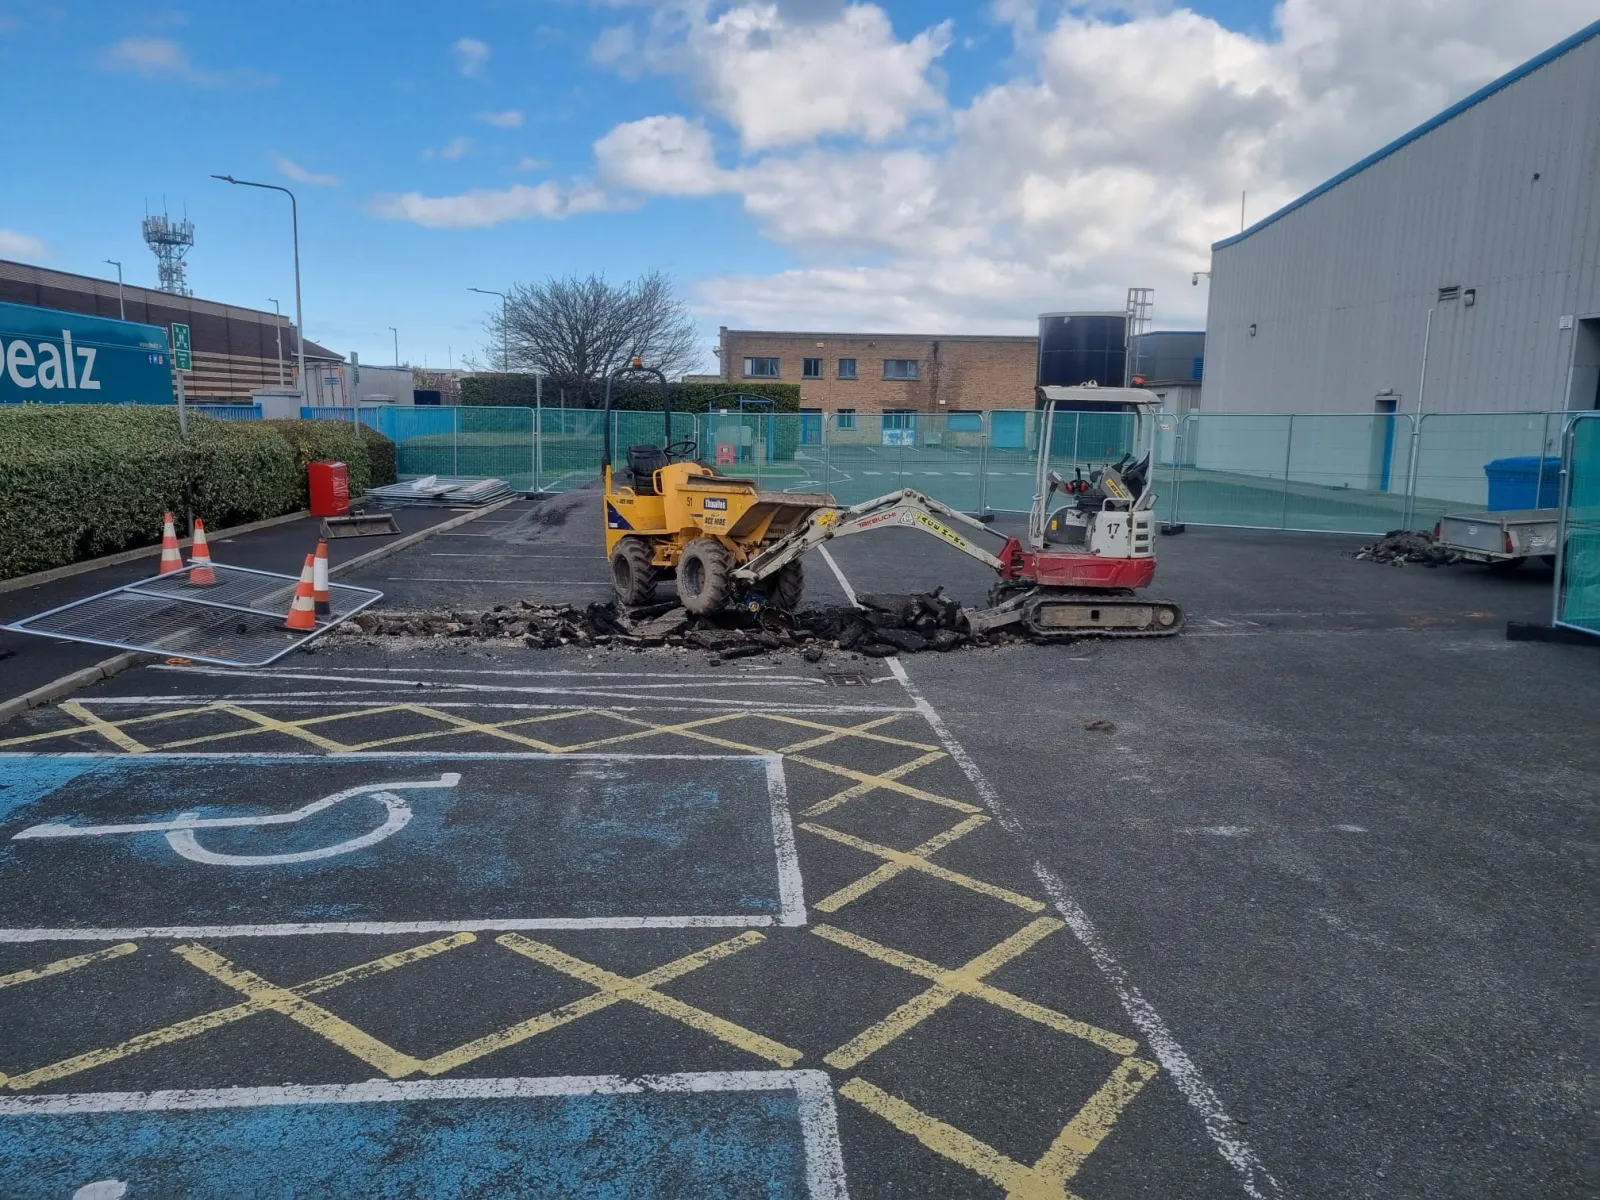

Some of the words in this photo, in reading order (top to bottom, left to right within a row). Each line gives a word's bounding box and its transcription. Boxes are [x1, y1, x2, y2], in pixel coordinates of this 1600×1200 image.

[0, 330, 101, 389] ealz
[686, 497, 692, 506] 51
[705, 499, 726, 509] Thwaites
[714, 518, 726, 526] HIRE
[857, 512, 897, 528] TAKEUCHI
[922, 517, 940, 530] ACE
[941, 529, 965, 547] HIRE
[1107, 523, 1120, 535] 17
